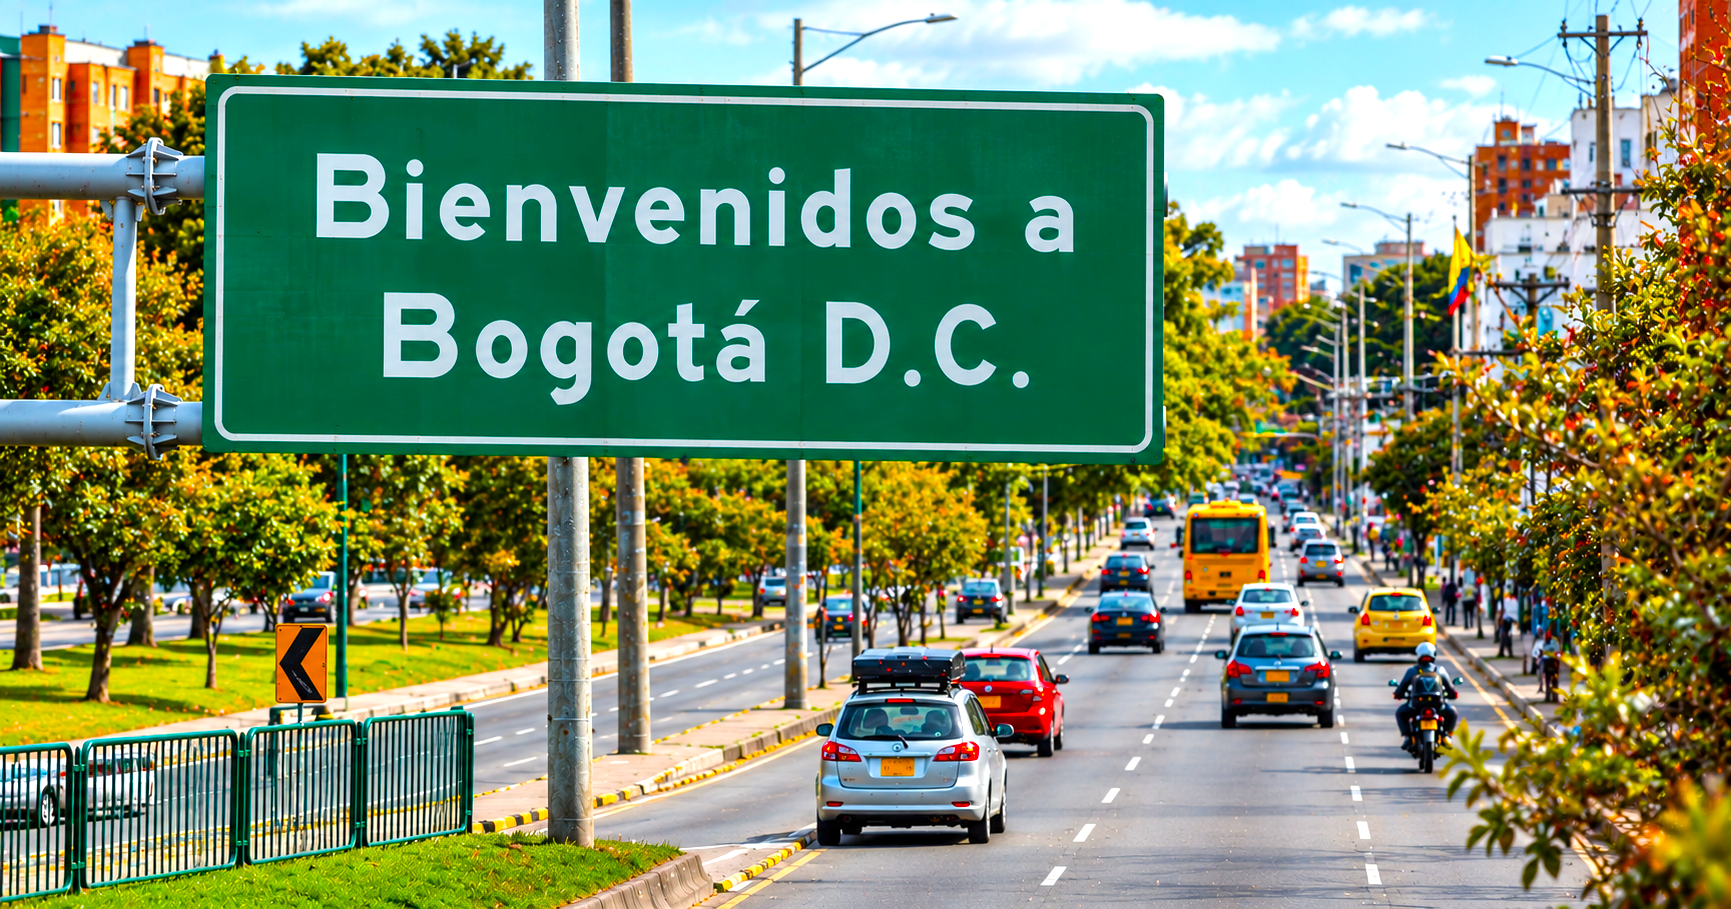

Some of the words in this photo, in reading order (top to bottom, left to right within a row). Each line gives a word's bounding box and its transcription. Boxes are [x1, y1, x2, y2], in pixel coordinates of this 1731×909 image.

[316, 153, 975, 251] Bienvenidos
[1025, 195, 1074, 253] a
[383, 292, 766, 406] Bogotá
[826, 301, 1030, 389] D.C.
